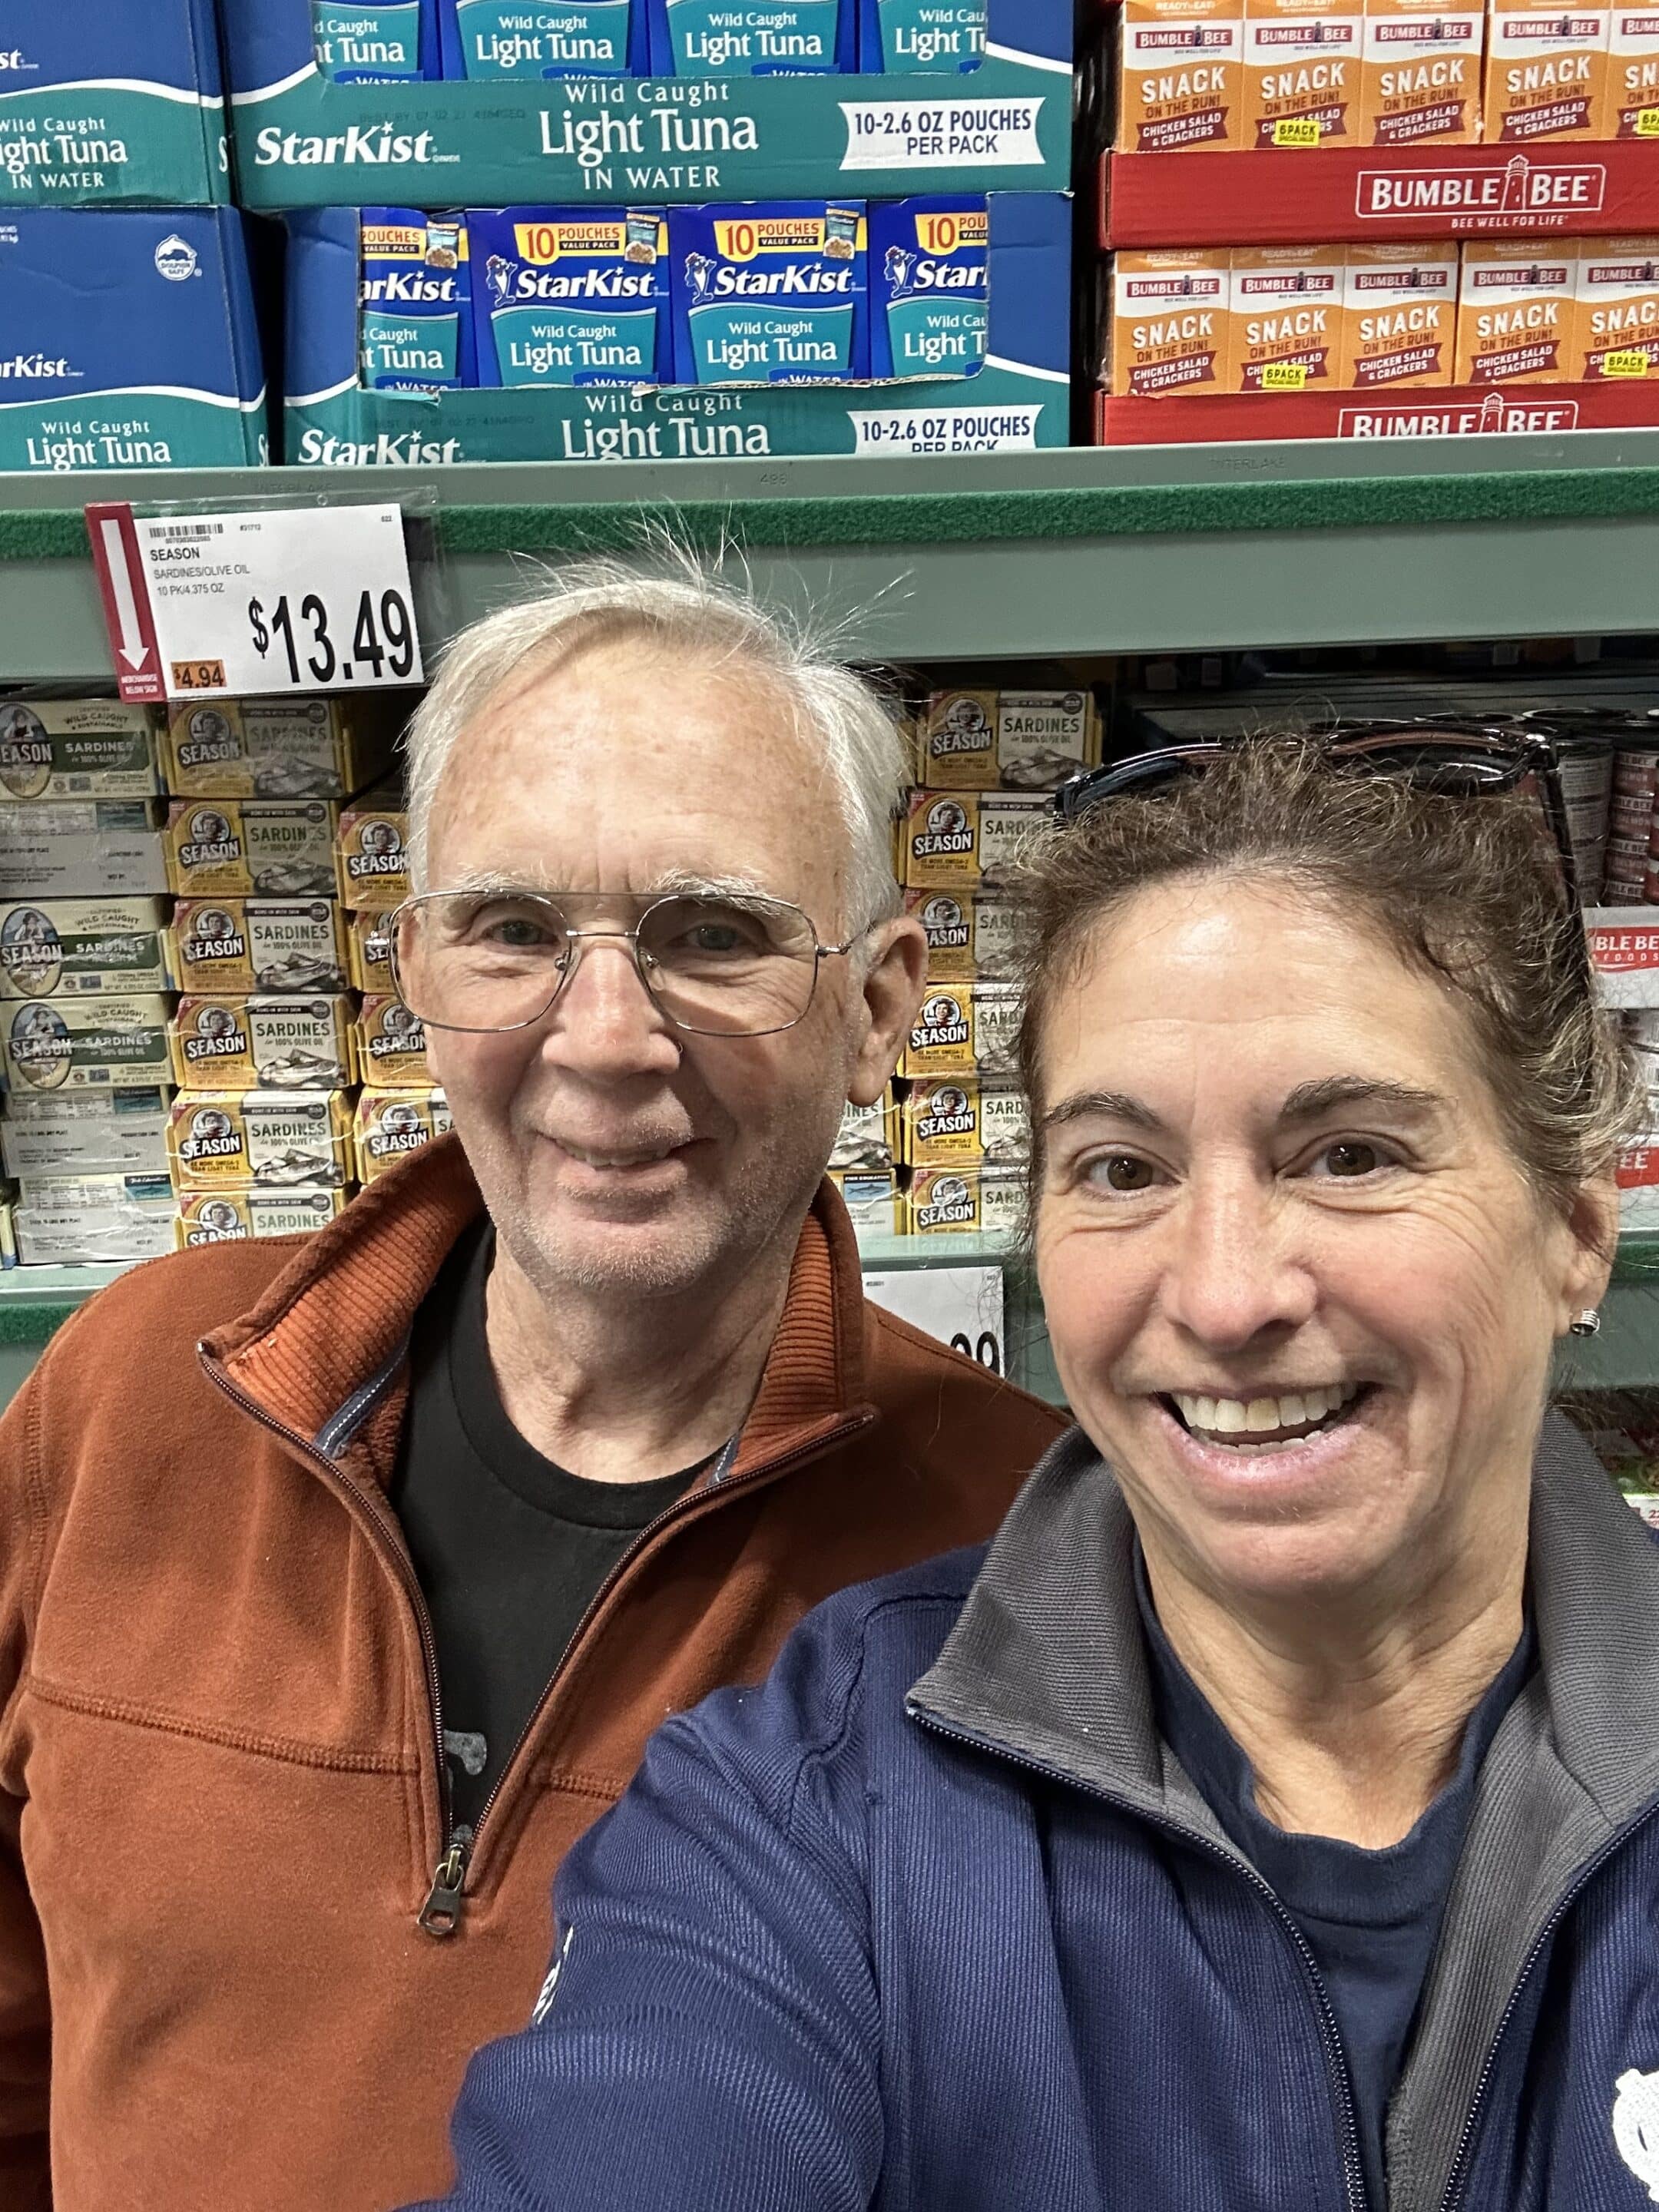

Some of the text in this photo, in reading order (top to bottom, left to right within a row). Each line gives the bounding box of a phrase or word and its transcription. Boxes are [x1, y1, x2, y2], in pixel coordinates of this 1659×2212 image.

[499, 15, 588, 32] Wild Caught
[708, 12, 797, 28] Wild Caught
[919, 9, 953, 22] Wild
[327, 19, 379, 36] Caught
[1260, 27, 1348, 44] BUMBLE BEE
[1508, 20, 1595, 37] BUMBLE BEE
[337, 37, 406, 63] Tuna
[475, 33, 614, 67] Light Tuna
[686, 30, 823, 65] Light Tuna
[895, 27, 961, 61] Light
[1140, 31, 1229, 48] BUMBLE BEE
[1141, 66, 1226, 104] SNACK
[1260, 61, 1345, 100] SNACK
[1506, 55, 1591, 93] SNACK
[565, 81, 729, 107] Wild Caught
[1146, 94, 1220, 118] ON THE RUN!
[1506, 101, 1585, 127] CHICKEN SALAD
[44, 117, 105, 134] Caught
[855, 109, 1031, 135] 10-2.6 OZ POUCHES
[1142, 113, 1221, 137] CHICKEN SALAD
[1522, 115, 1577, 135] CRACKERS
[255, 121, 433, 165] StarKist
[540, 108, 759, 167] Light Tuna
[906, 135, 998, 155] PER PACK
[1160, 127, 1214, 145] CRACKERS
[0, 135, 128, 174] ight Tuna
[12, 172, 105, 188] IN WATER
[584, 166, 720, 190] IN WATER
[1371, 174, 1591, 210] BUMBLE BEE
[928, 217, 955, 248] 10
[1452, 216, 1565, 228] BEE WELL FOR LIFE
[526, 227, 620, 259] 10 POUCHES
[726, 223, 820, 256] 10 POUCHES
[516, 267, 654, 298] StarKist
[714, 262, 852, 296] StarKist
[1131, 279, 1216, 296] BUMBLE BEE
[1359, 273, 1444, 288] BUMBLE BEE
[1478, 269, 1563, 285] BUMBLE BEE
[1133, 313, 1213, 349] SNACK
[1359, 305, 1441, 341] SNACK
[1476, 303, 1558, 338] SNACK
[531, 325, 616, 340] Wild Caught
[1480, 329, 1552, 351] ON THE RUN!
[510, 342, 642, 373] Light Tuna
[1137, 341, 1208, 363] ON THE RUN!
[1359, 348, 1435, 372] CHICKEN SALAD
[1134, 356, 1209, 380] CHICKEN SALAD
[1151, 370, 1202, 388] CRACKERS
[1376, 360, 1428, 379] CRACKERS
[586, 393, 742, 416] Wild Caught
[41, 421, 150, 436] Wild Caught
[561, 417, 771, 461] Light Tuna
[863, 416, 1031, 442] 10-2.6 OZ POUCHES
[26, 436, 172, 471] Light Tuna
[298, 430, 460, 465] StarKist
[151, 547, 200, 561] SEASON
[154, 565, 250, 579] SARDINES/OLIVE OIL
[157, 586, 167, 596] 10
[210, 583, 225, 594] OZ
[174, 666, 224, 688] $4.94
[1004, 717, 1080, 733] SARDINES
[0, 743, 52, 763] EASON
[65, 741, 134, 753] SARDINES
[180, 743, 240, 764] SEASON
[933, 732, 991, 755] SEASON
[250, 826, 326, 842] SARDINES
[915, 833, 972, 855] SEASON
[180, 840, 240, 866] SEASON
[102, 914, 139, 924] CAUGHT
[254, 926, 329, 939] SARDINES
[1634, 935, 1659, 950] BE
[1, 945, 63, 964] SEASON
[76, 942, 144, 952] SARDINES
[187, 940, 243, 960] SEASON
[257, 1022, 330, 1036] SARDINES
[912, 1025, 966, 1048] SEASON
[85, 1035, 151, 1046] SARDINES
[187, 1036, 244, 1058] SEASON
[986, 1101, 1022, 1114] SARD
[251, 1122, 326, 1137] SARDINES
[920, 1116, 973, 1137] SEASON
[183, 1137, 240, 1160] SEASON
[372, 1131, 427, 1154] SEASON
[257, 1214, 329, 1229] SARDINES
[920, 1203, 973, 1226] SEASON
